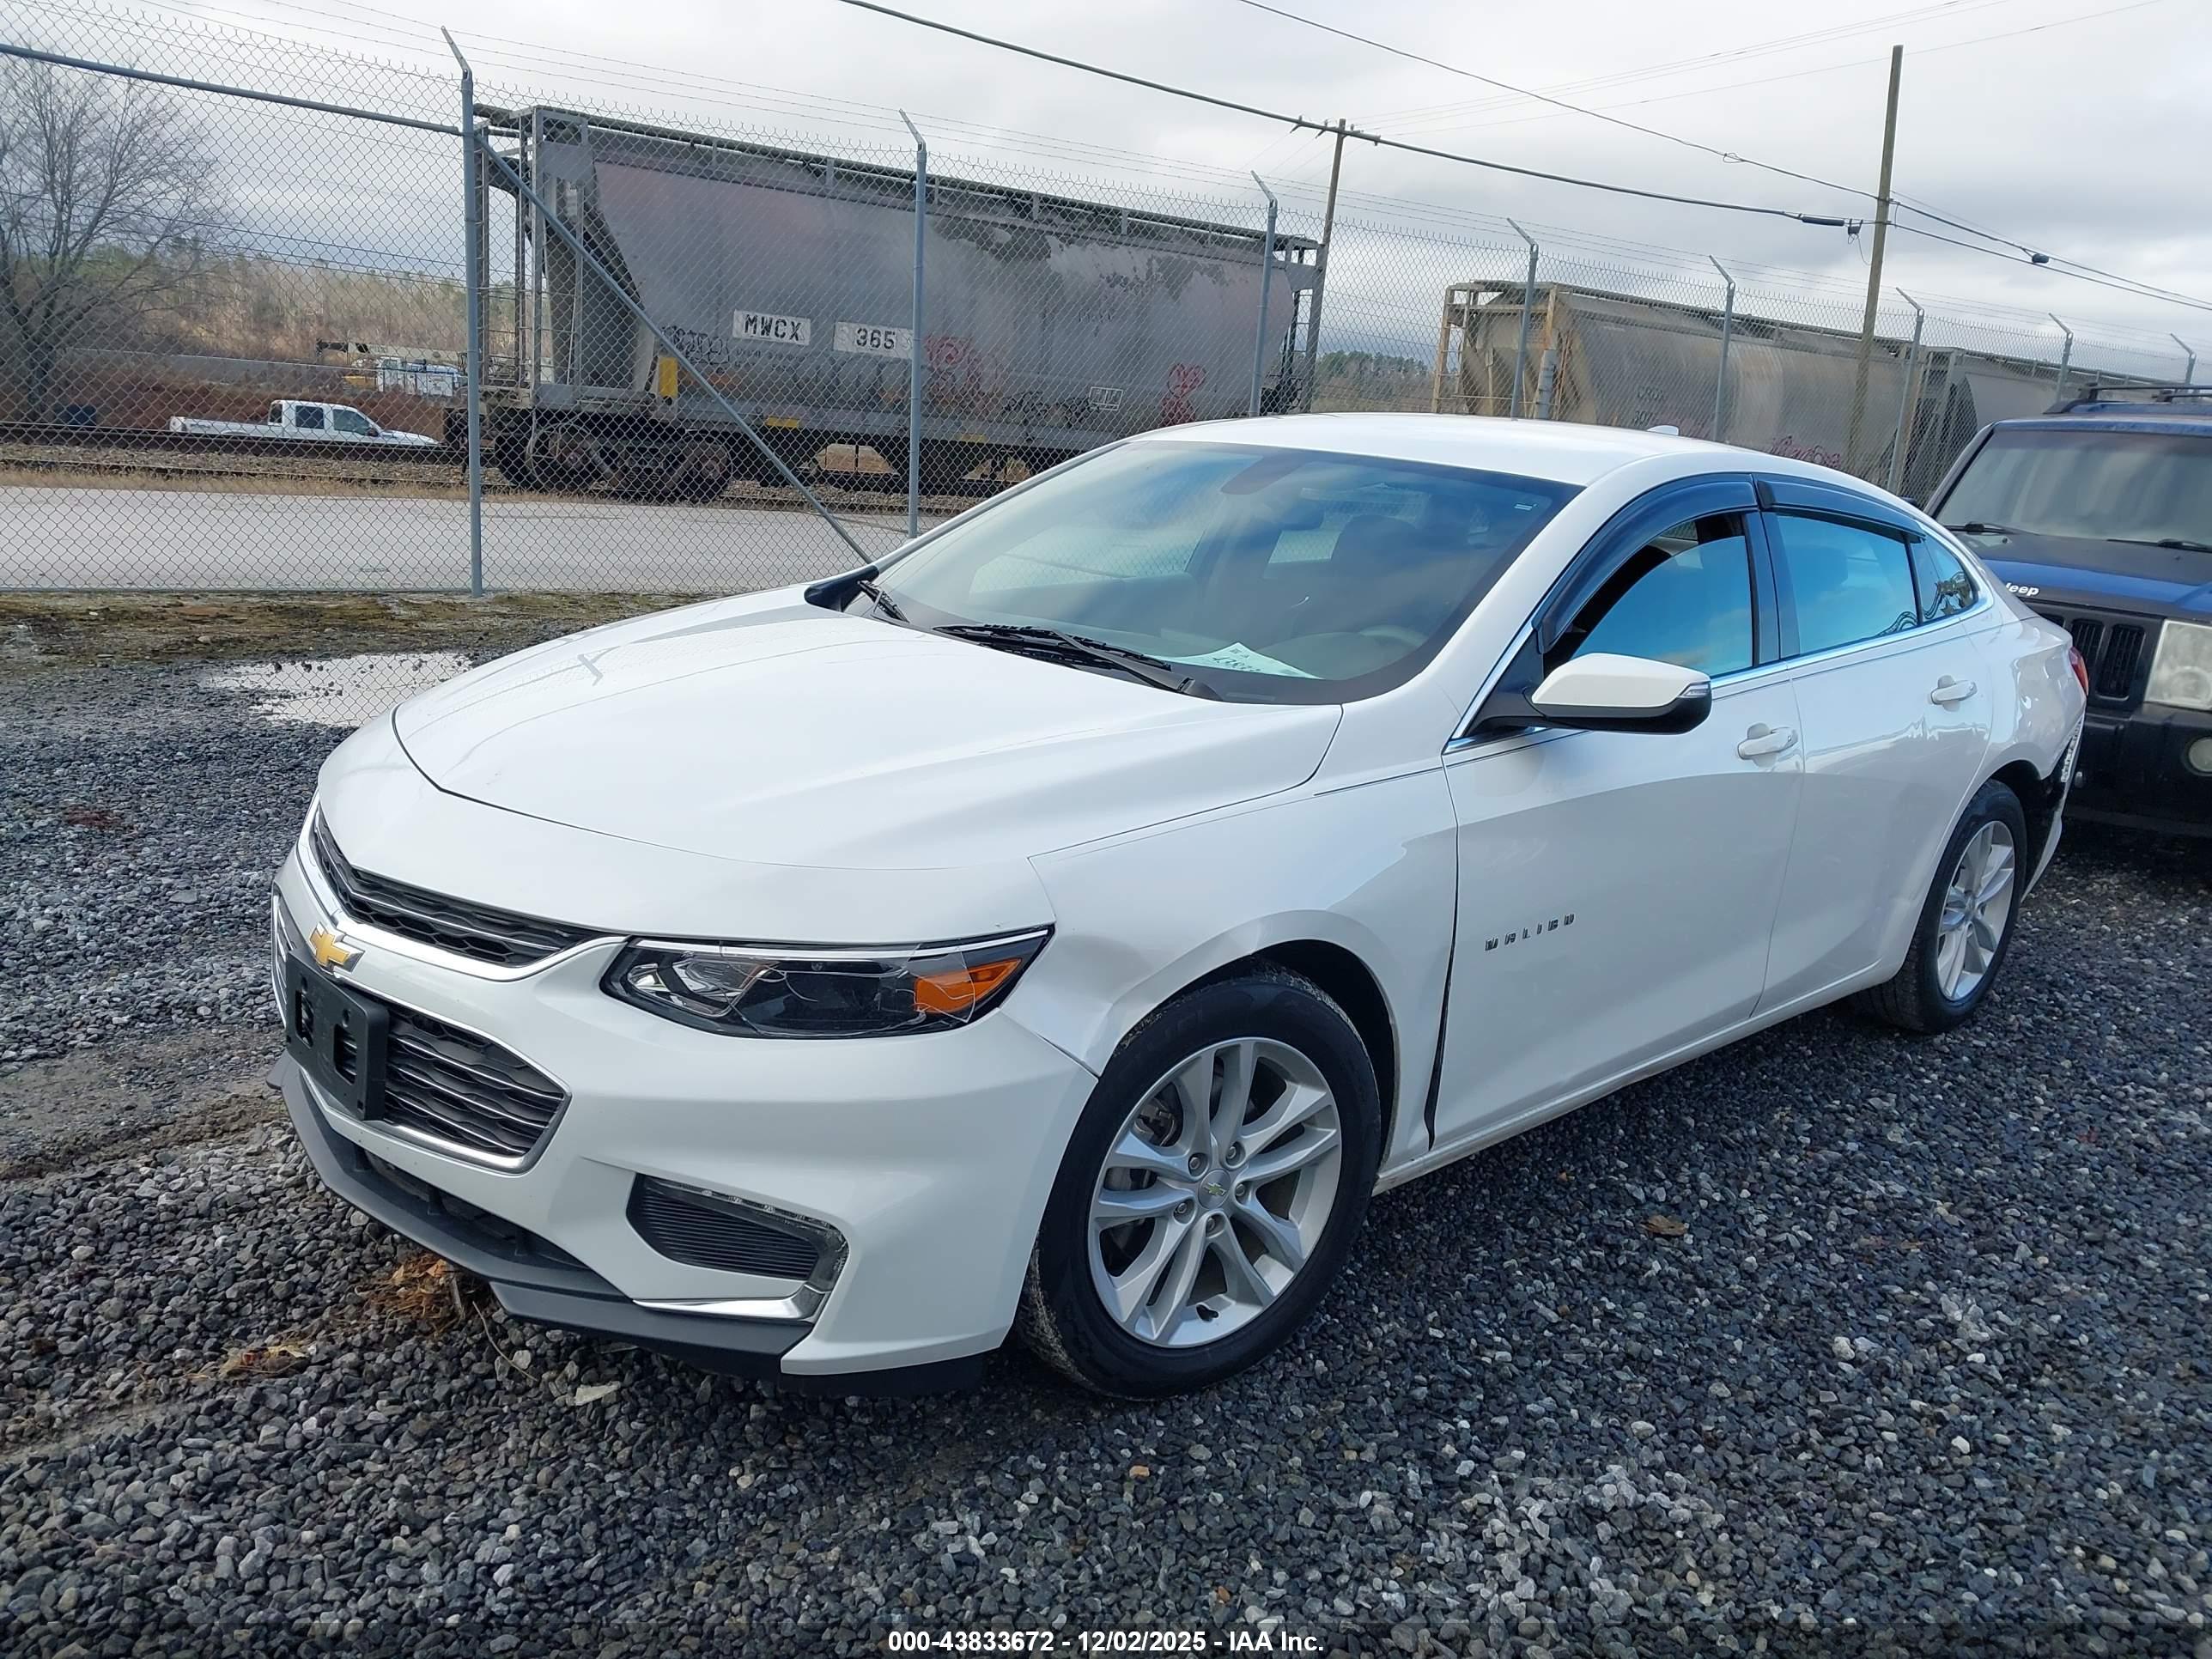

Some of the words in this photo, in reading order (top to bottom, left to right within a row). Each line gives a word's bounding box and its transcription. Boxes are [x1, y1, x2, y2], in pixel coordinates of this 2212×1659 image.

[744, 313, 803, 342] MWCX
[855, 327, 896, 350] 365
[1485, 913, 1575, 951] MALIBU
